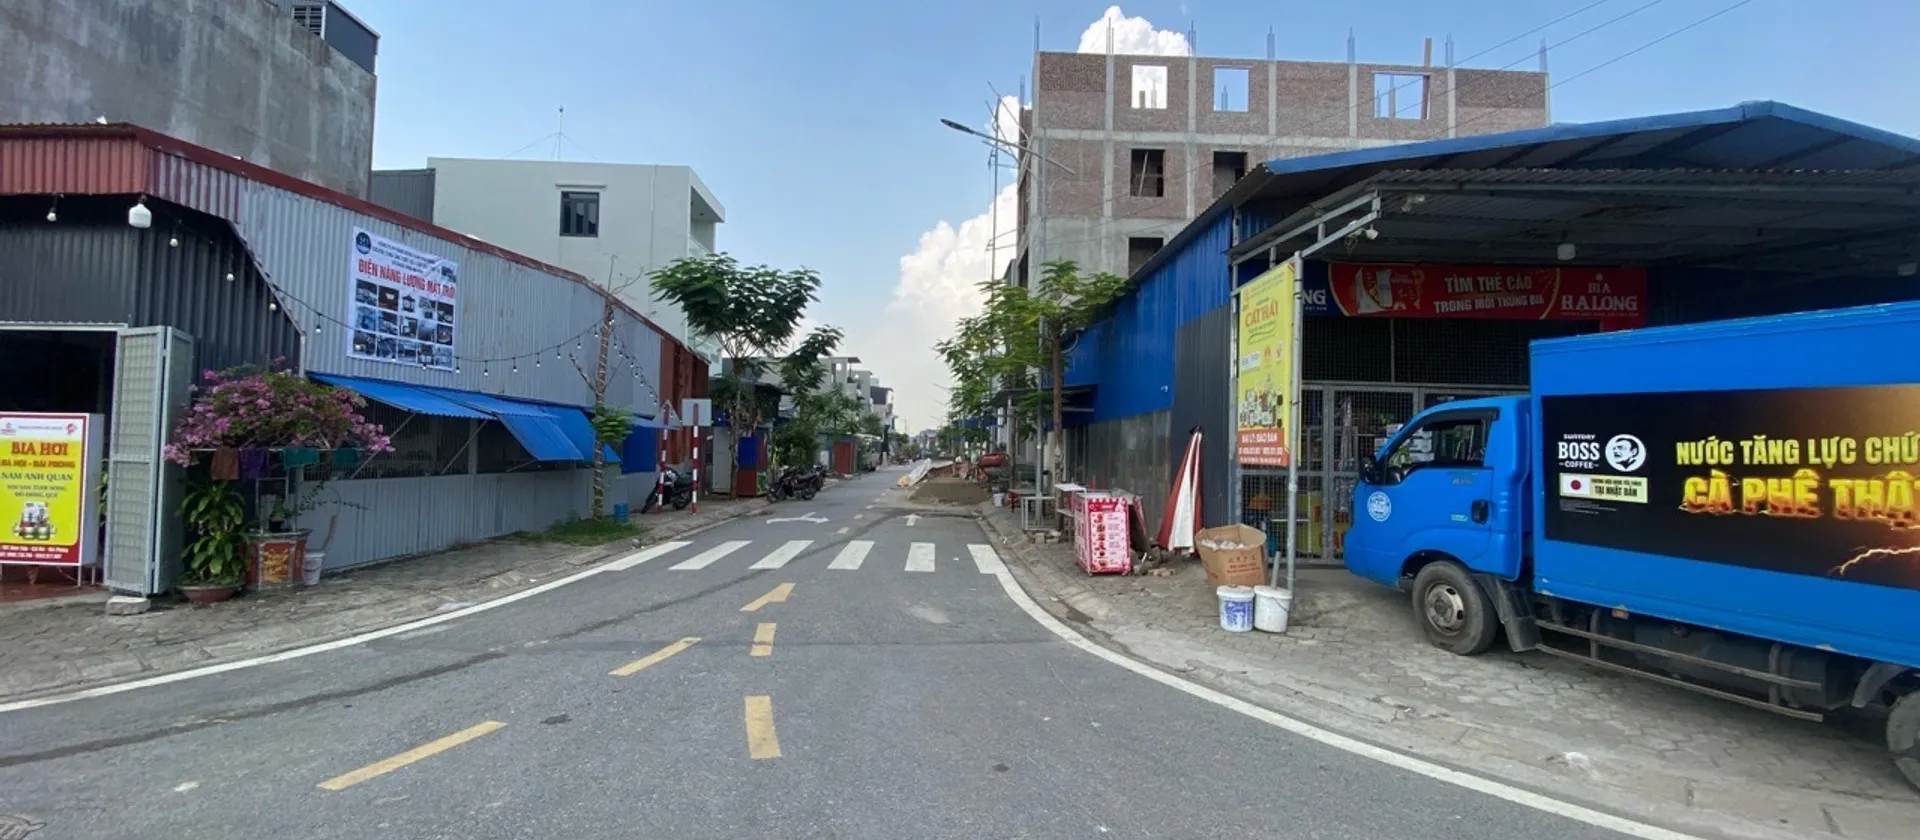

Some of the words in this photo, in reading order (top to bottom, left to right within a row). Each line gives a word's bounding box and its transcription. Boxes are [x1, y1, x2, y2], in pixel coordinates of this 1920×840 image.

[1444, 272, 1474, 294] TÌM
[1477, 271, 1504, 292] THẺ
[1587, 282, 1612, 294] BIA
[1433, 299, 1472, 314] TRONG
[11, 441, 36, 456] BIA
[1558, 442, 1600, 461] BOSS
[1676, 435, 1734, 465] NƯỚC
[1740, 434, 1800, 465] TĂNG
[1807, 437, 1857, 469] LỰC
[1564, 460, 1594, 469] COFFEE
[1594, 485, 1605, 496] TẠI
[1606, 485, 1622, 498] NHẬT
[1623, 486, 1638, 497] BẢN
[1683, 468, 1734, 514] CÀ
[1741, 468, 1821, 518] PHÊ
